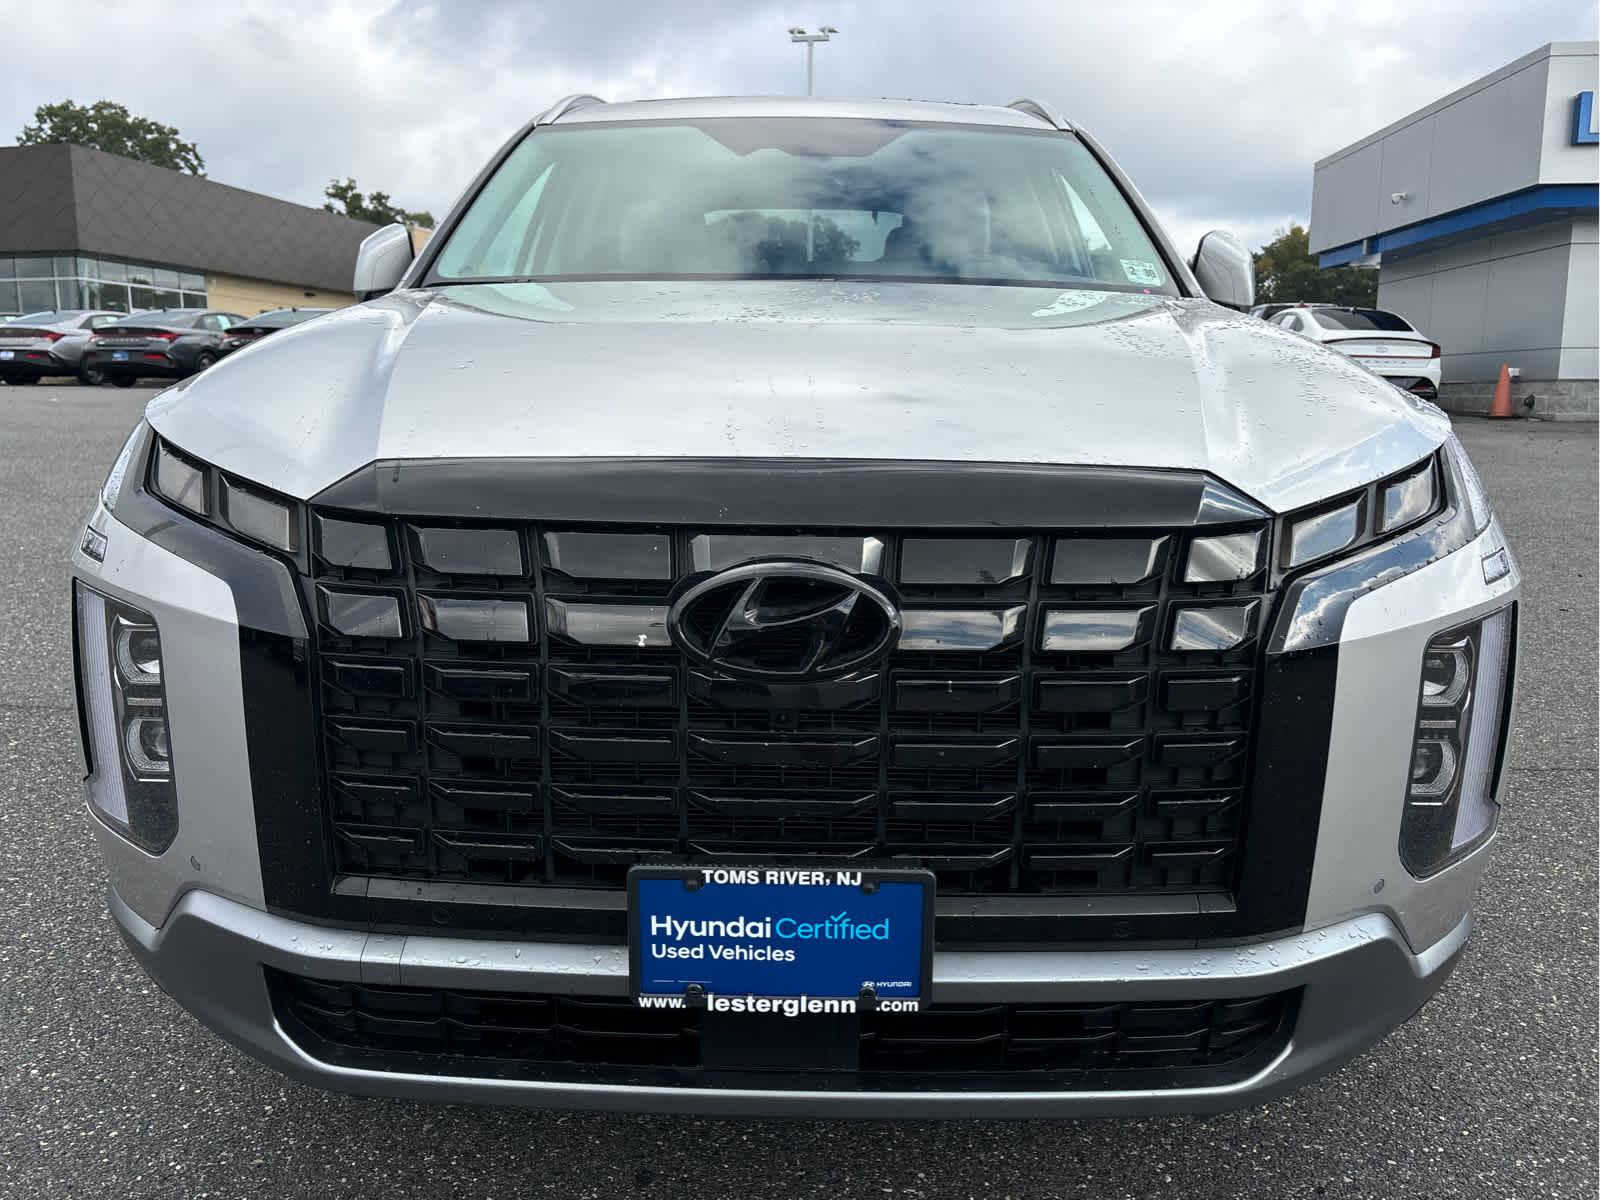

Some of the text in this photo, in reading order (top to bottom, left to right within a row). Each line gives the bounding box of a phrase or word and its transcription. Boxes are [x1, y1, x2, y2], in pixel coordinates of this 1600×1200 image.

[701, 869, 863, 887] TOMS RIVER, NJ
[650, 911, 890, 941] Hyundai Certified
[651, 943, 796, 962] Used Vehicles
[638, 994, 919, 1018] www. lesterglenn .com
